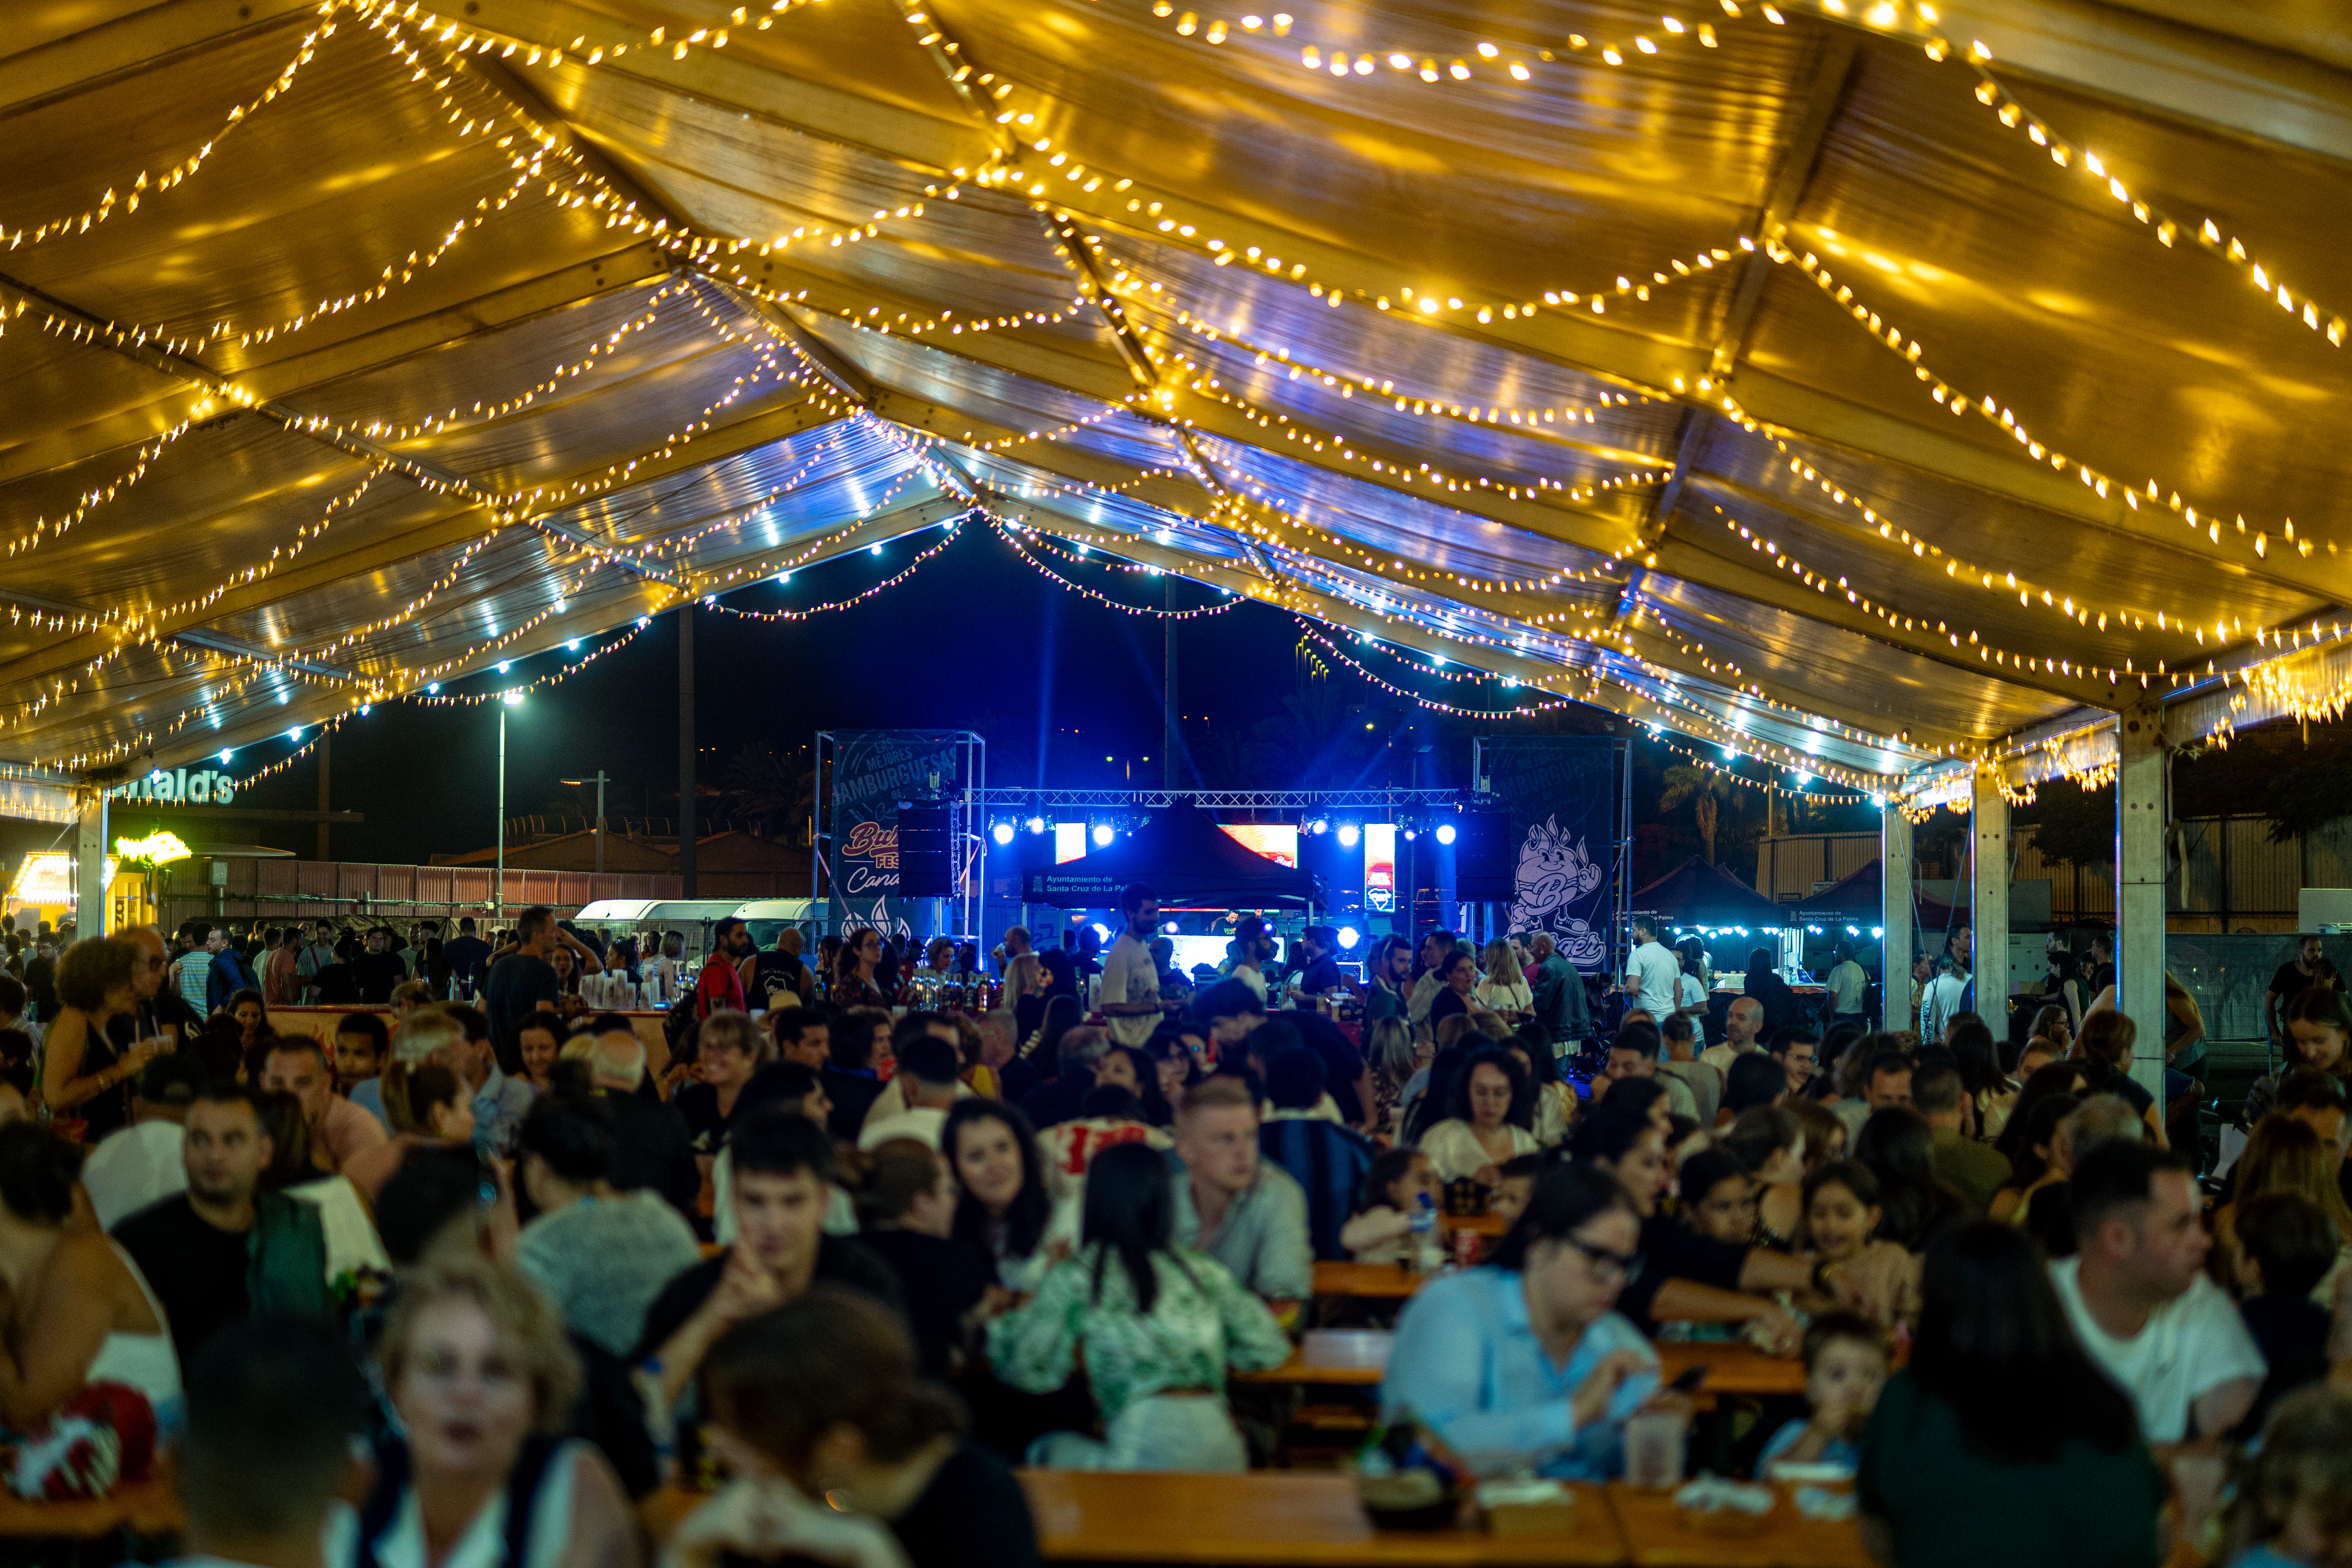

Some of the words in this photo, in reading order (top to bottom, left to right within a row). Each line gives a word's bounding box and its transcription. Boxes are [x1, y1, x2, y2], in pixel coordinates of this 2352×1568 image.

[874, 738, 894, 754] LAS
[866, 746, 913, 771] MEJORES
[891, 789, 902, 799] DE
[875, 855, 899, 869] FES
[847, 867, 899, 893] Cana
[1047, 875, 1101, 884] Ayuntamiento
